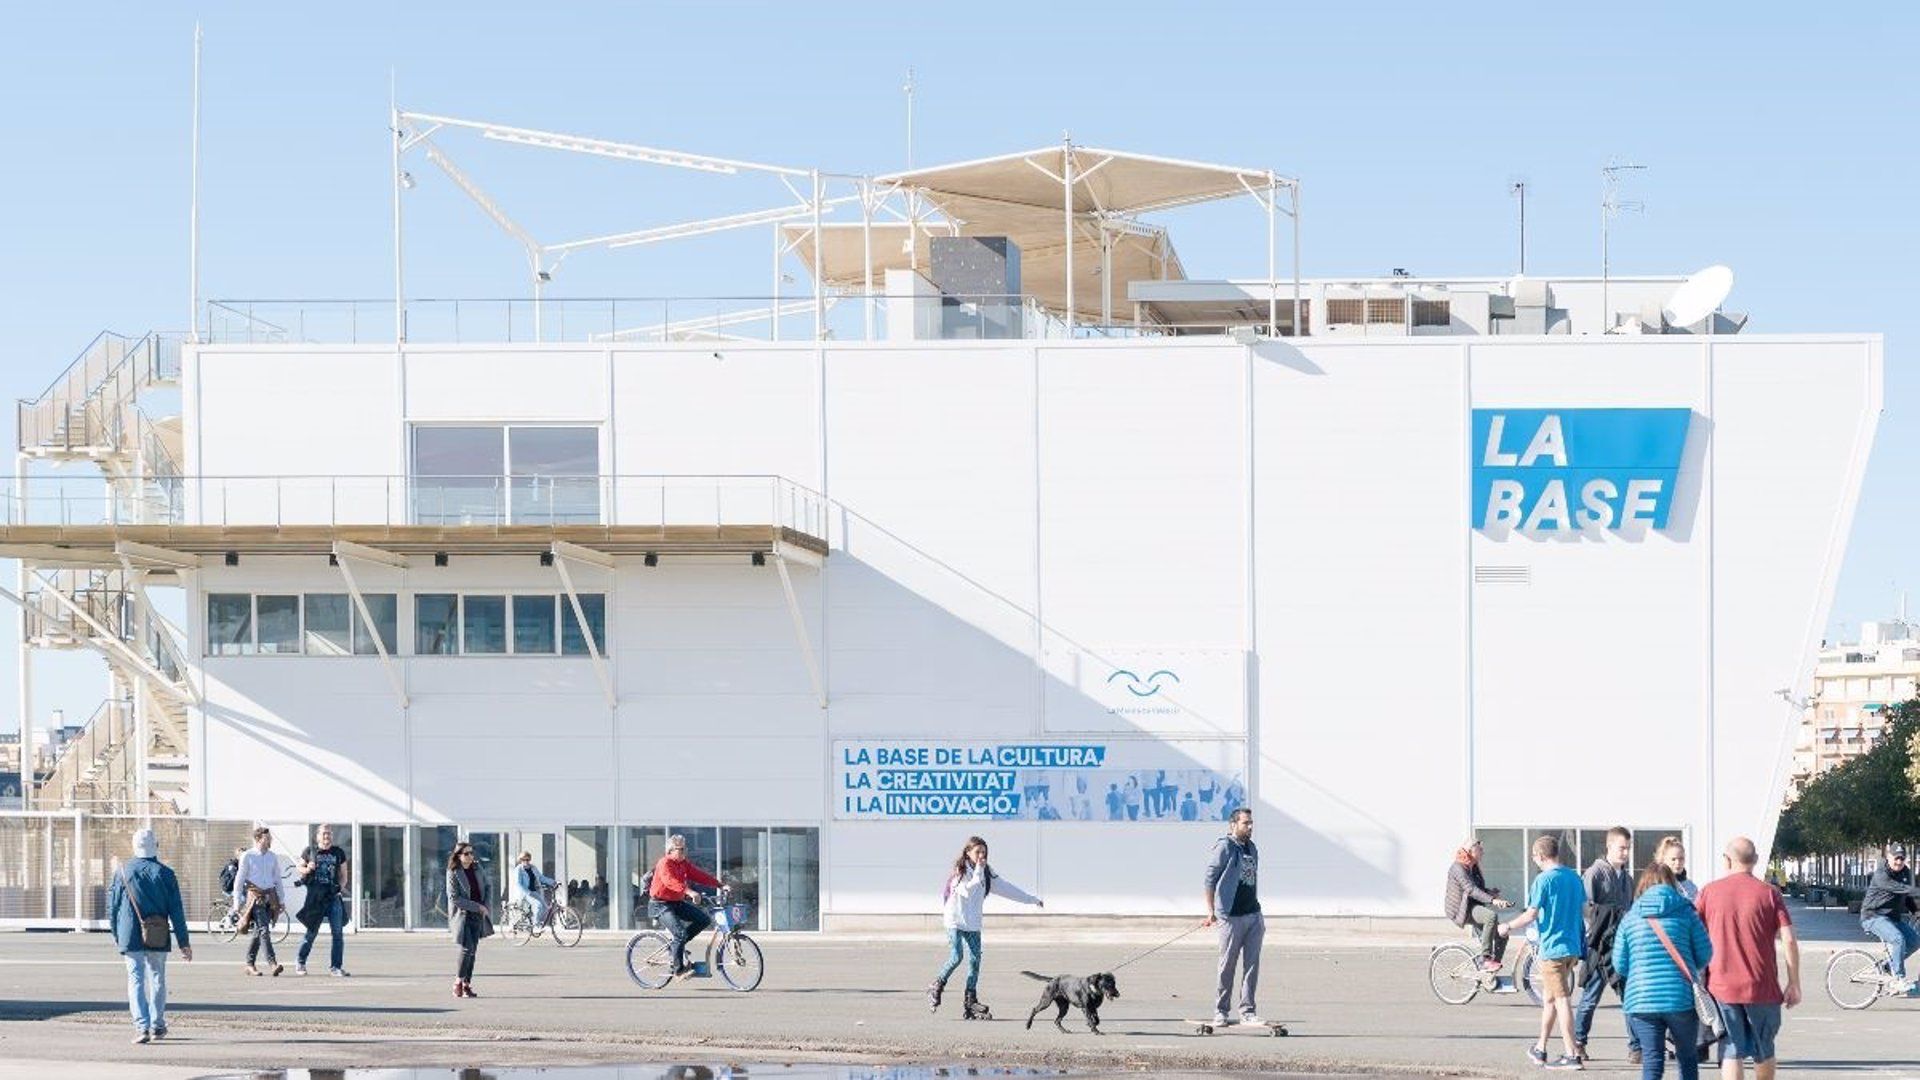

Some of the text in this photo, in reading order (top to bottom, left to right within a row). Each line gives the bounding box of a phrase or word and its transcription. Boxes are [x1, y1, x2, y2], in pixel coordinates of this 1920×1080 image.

[1483, 415, 1568, 466] LA
[1483, 479, 1663, 531] BASE
[844, 748, 871, 765] LA
[877, 748, 929, 765] BASE
[935, 748, 963, 765] DE
[968, 748, 994, 765] LA
[845, 772, 1013, 790] LA CREATIVITAT
[846, 790, 1017, 814] I LA INNOVACIÓ.
